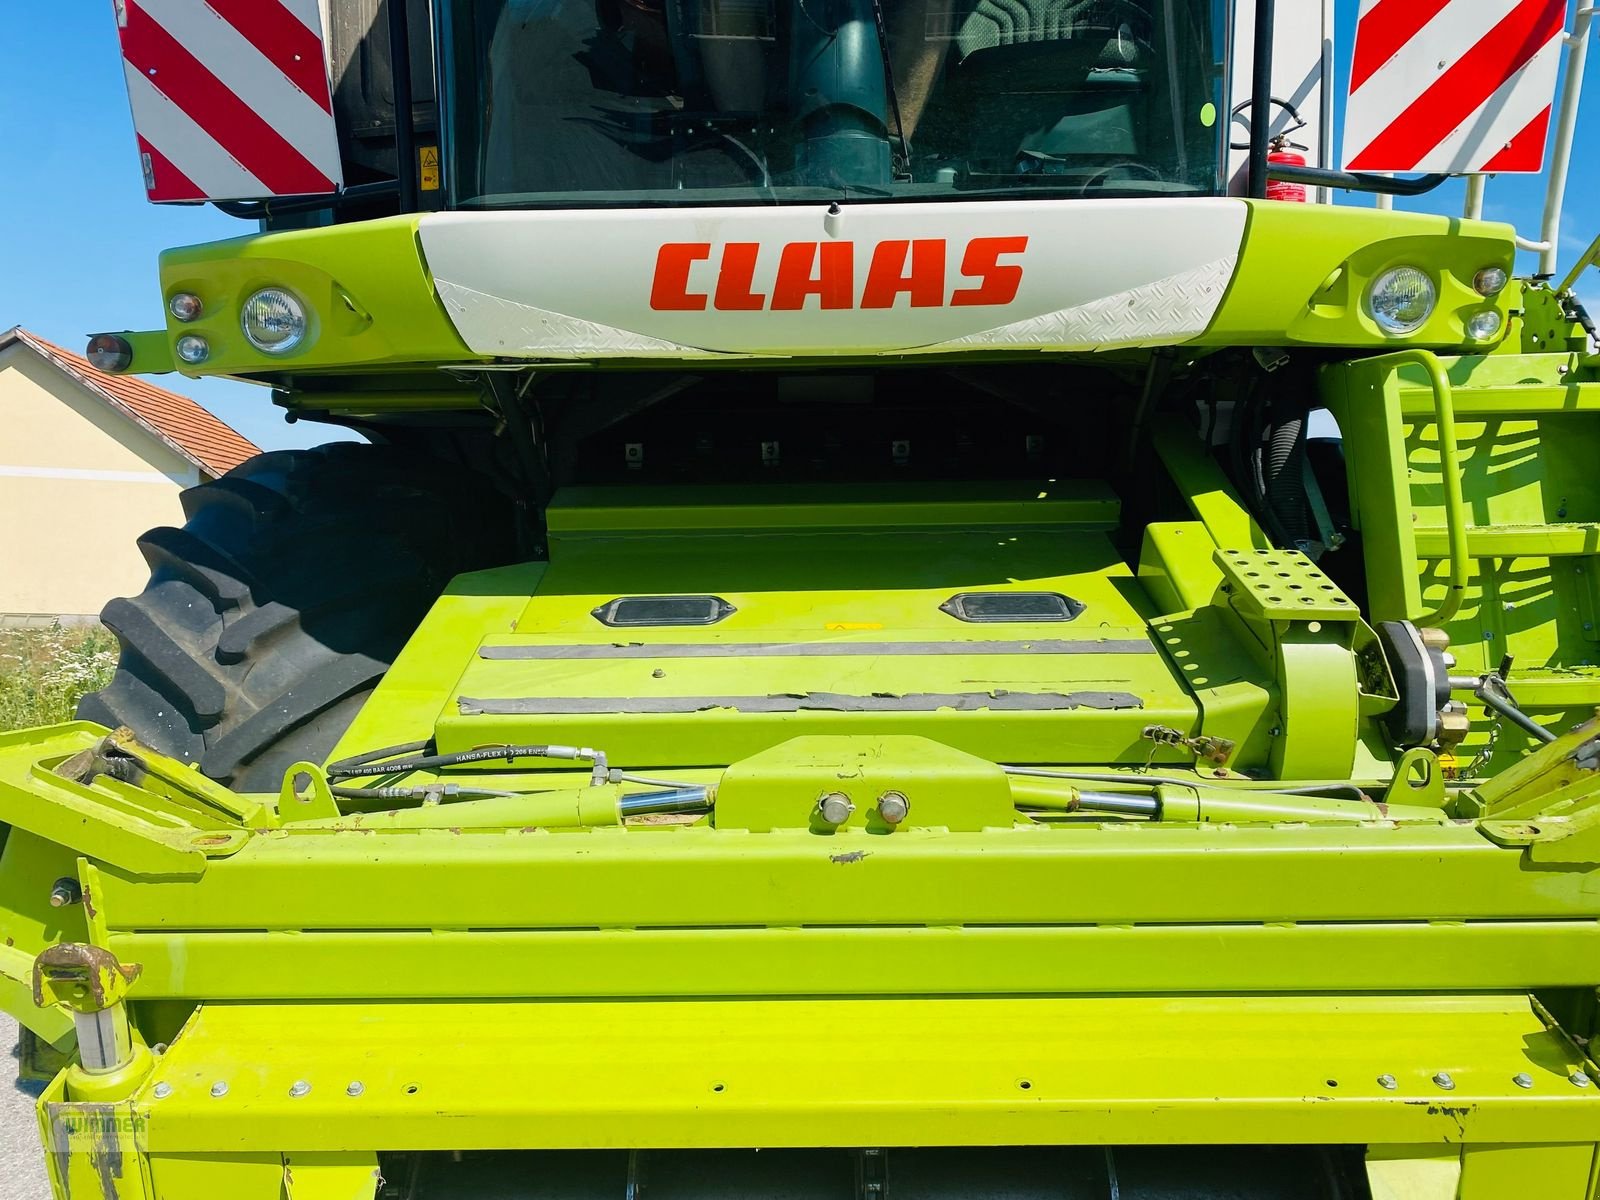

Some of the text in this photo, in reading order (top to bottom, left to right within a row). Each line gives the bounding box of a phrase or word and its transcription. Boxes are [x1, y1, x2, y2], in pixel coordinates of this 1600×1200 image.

[650, 236, 1029, 311] CLAAS
[456, 749, 502, 763] HANSA-FLEX
[372, 766, 386, 774] BAR
